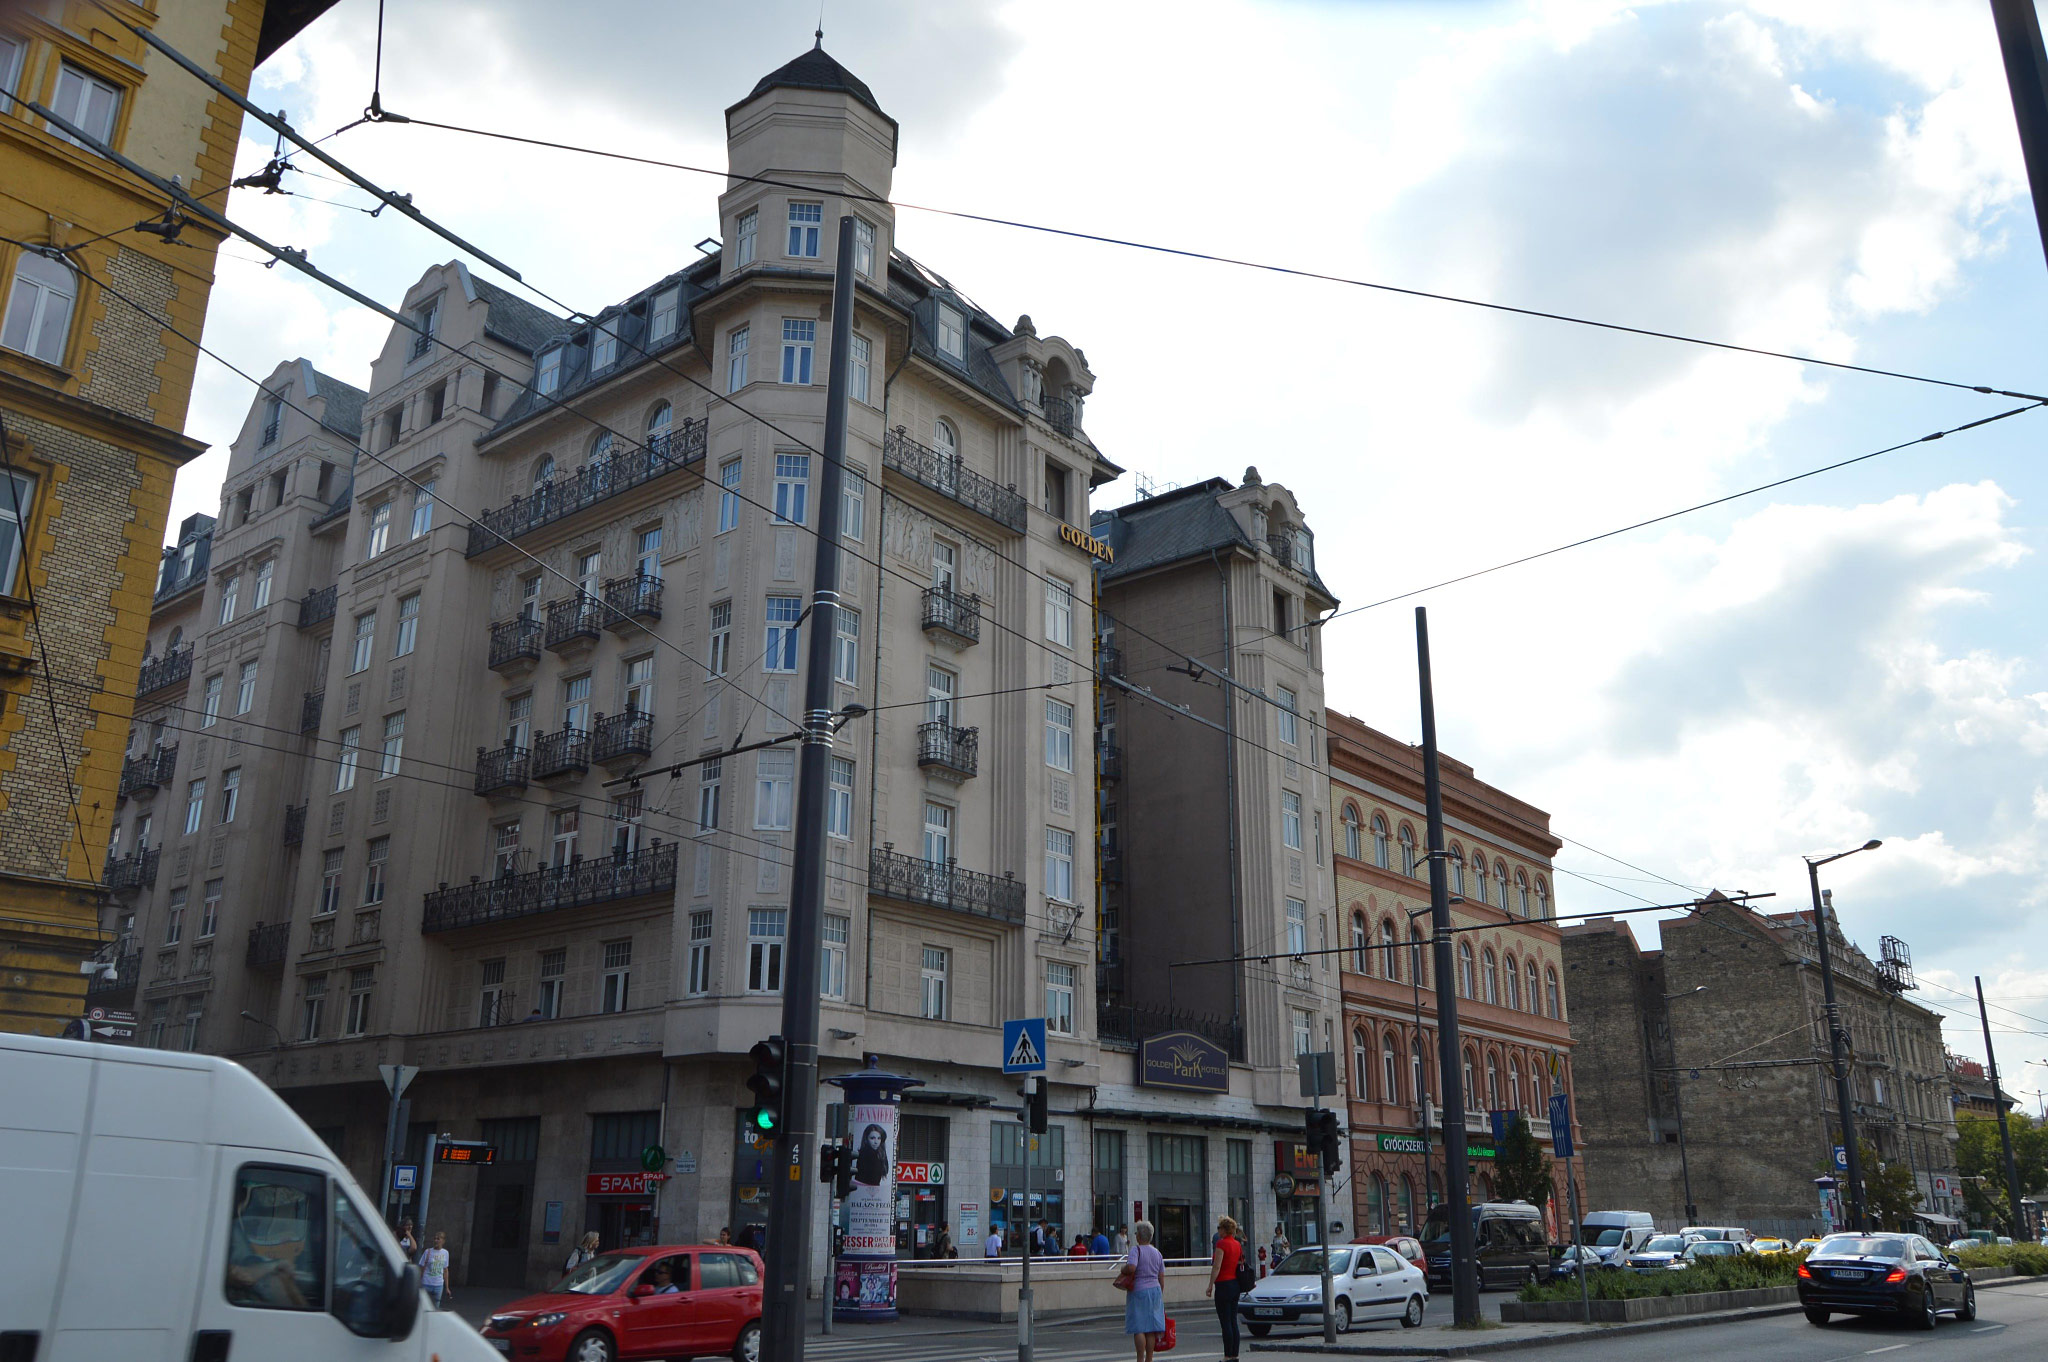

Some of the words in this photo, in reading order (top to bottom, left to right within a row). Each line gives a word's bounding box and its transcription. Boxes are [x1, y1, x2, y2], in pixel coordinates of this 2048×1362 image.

[1060, 523, 1114, 563] GOLDEN
[1146, 1059, 1174, 1069] GOLDEN
[1201, 1066, 1226, 1076] HOTELS
[1383, 1137, 1433, 1153] GYÓGYSZERTR
[600, 1177, 643, 1191] SPAR
